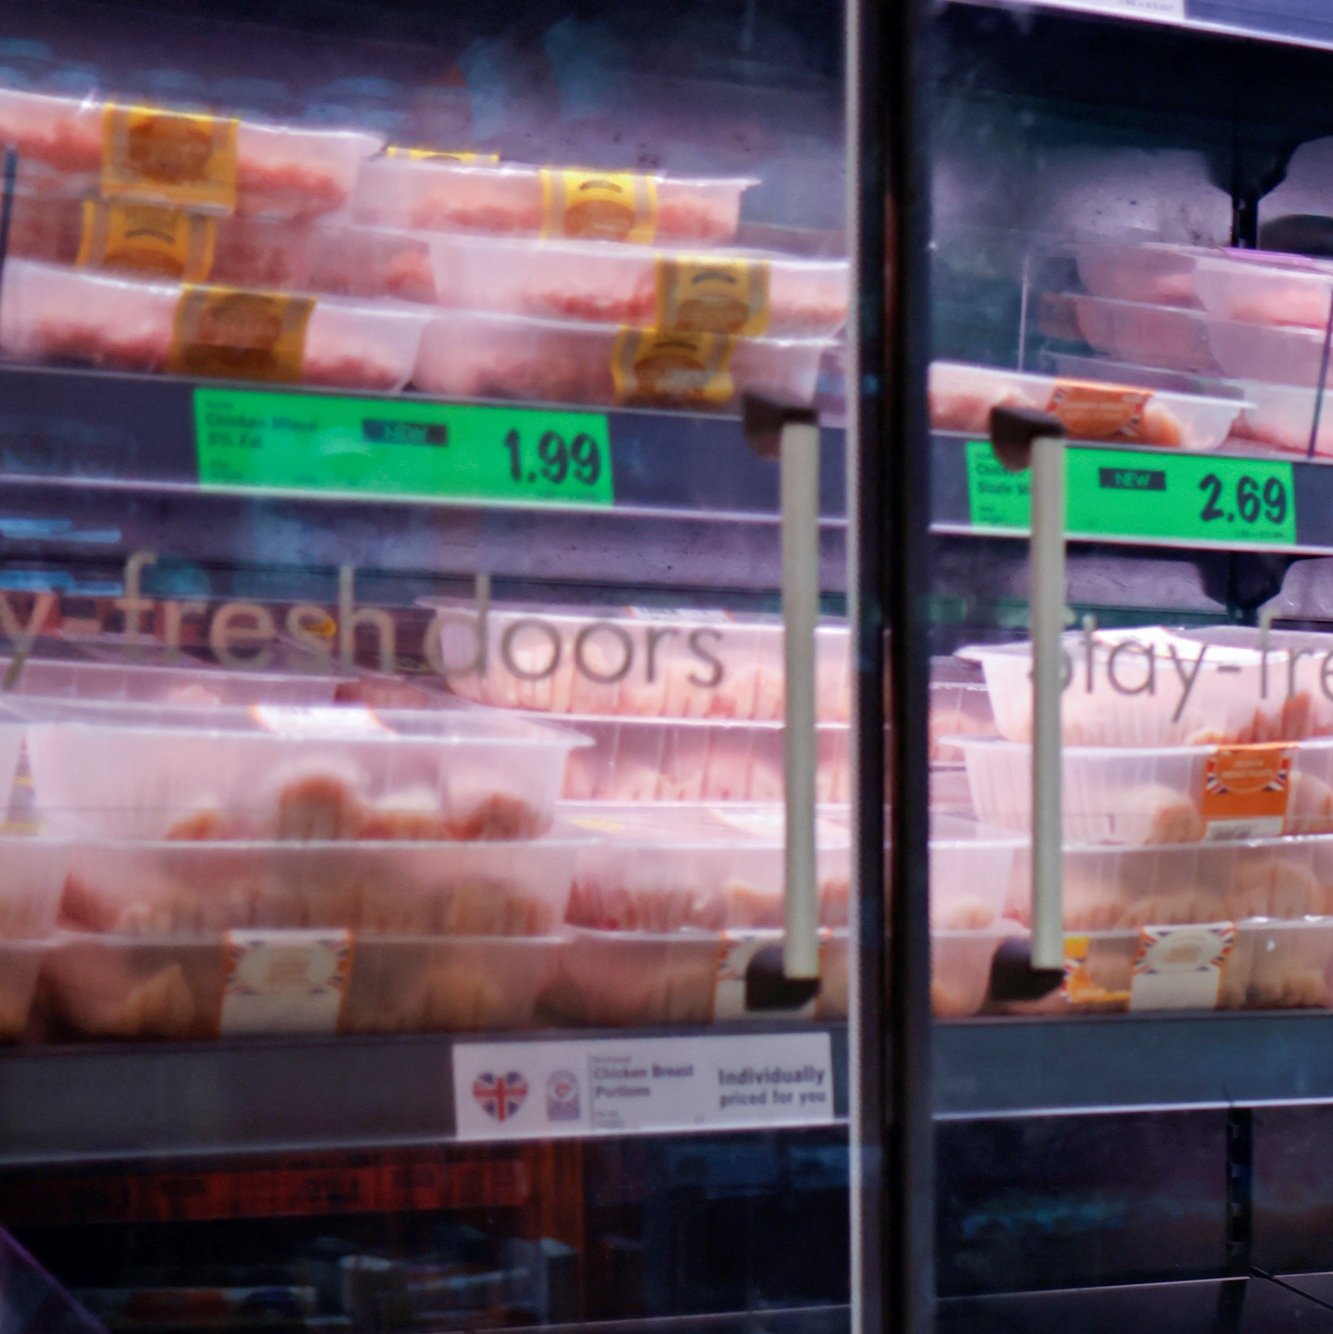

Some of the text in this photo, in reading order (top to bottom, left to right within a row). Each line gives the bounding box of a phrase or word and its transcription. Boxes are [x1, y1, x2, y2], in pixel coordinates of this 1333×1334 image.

[503, 427, 601, 486] 1.99
[1115, 471, 1151, 488] NEW
[1199, 472, 1288, 524] 2.69
[427, 572, 725, 690] doors
[594, 1063, 694, 1081] Chicken Breast
[718, 1065, 826, 1087] Individually
[720, 1089, 827, 1110] priced for you
